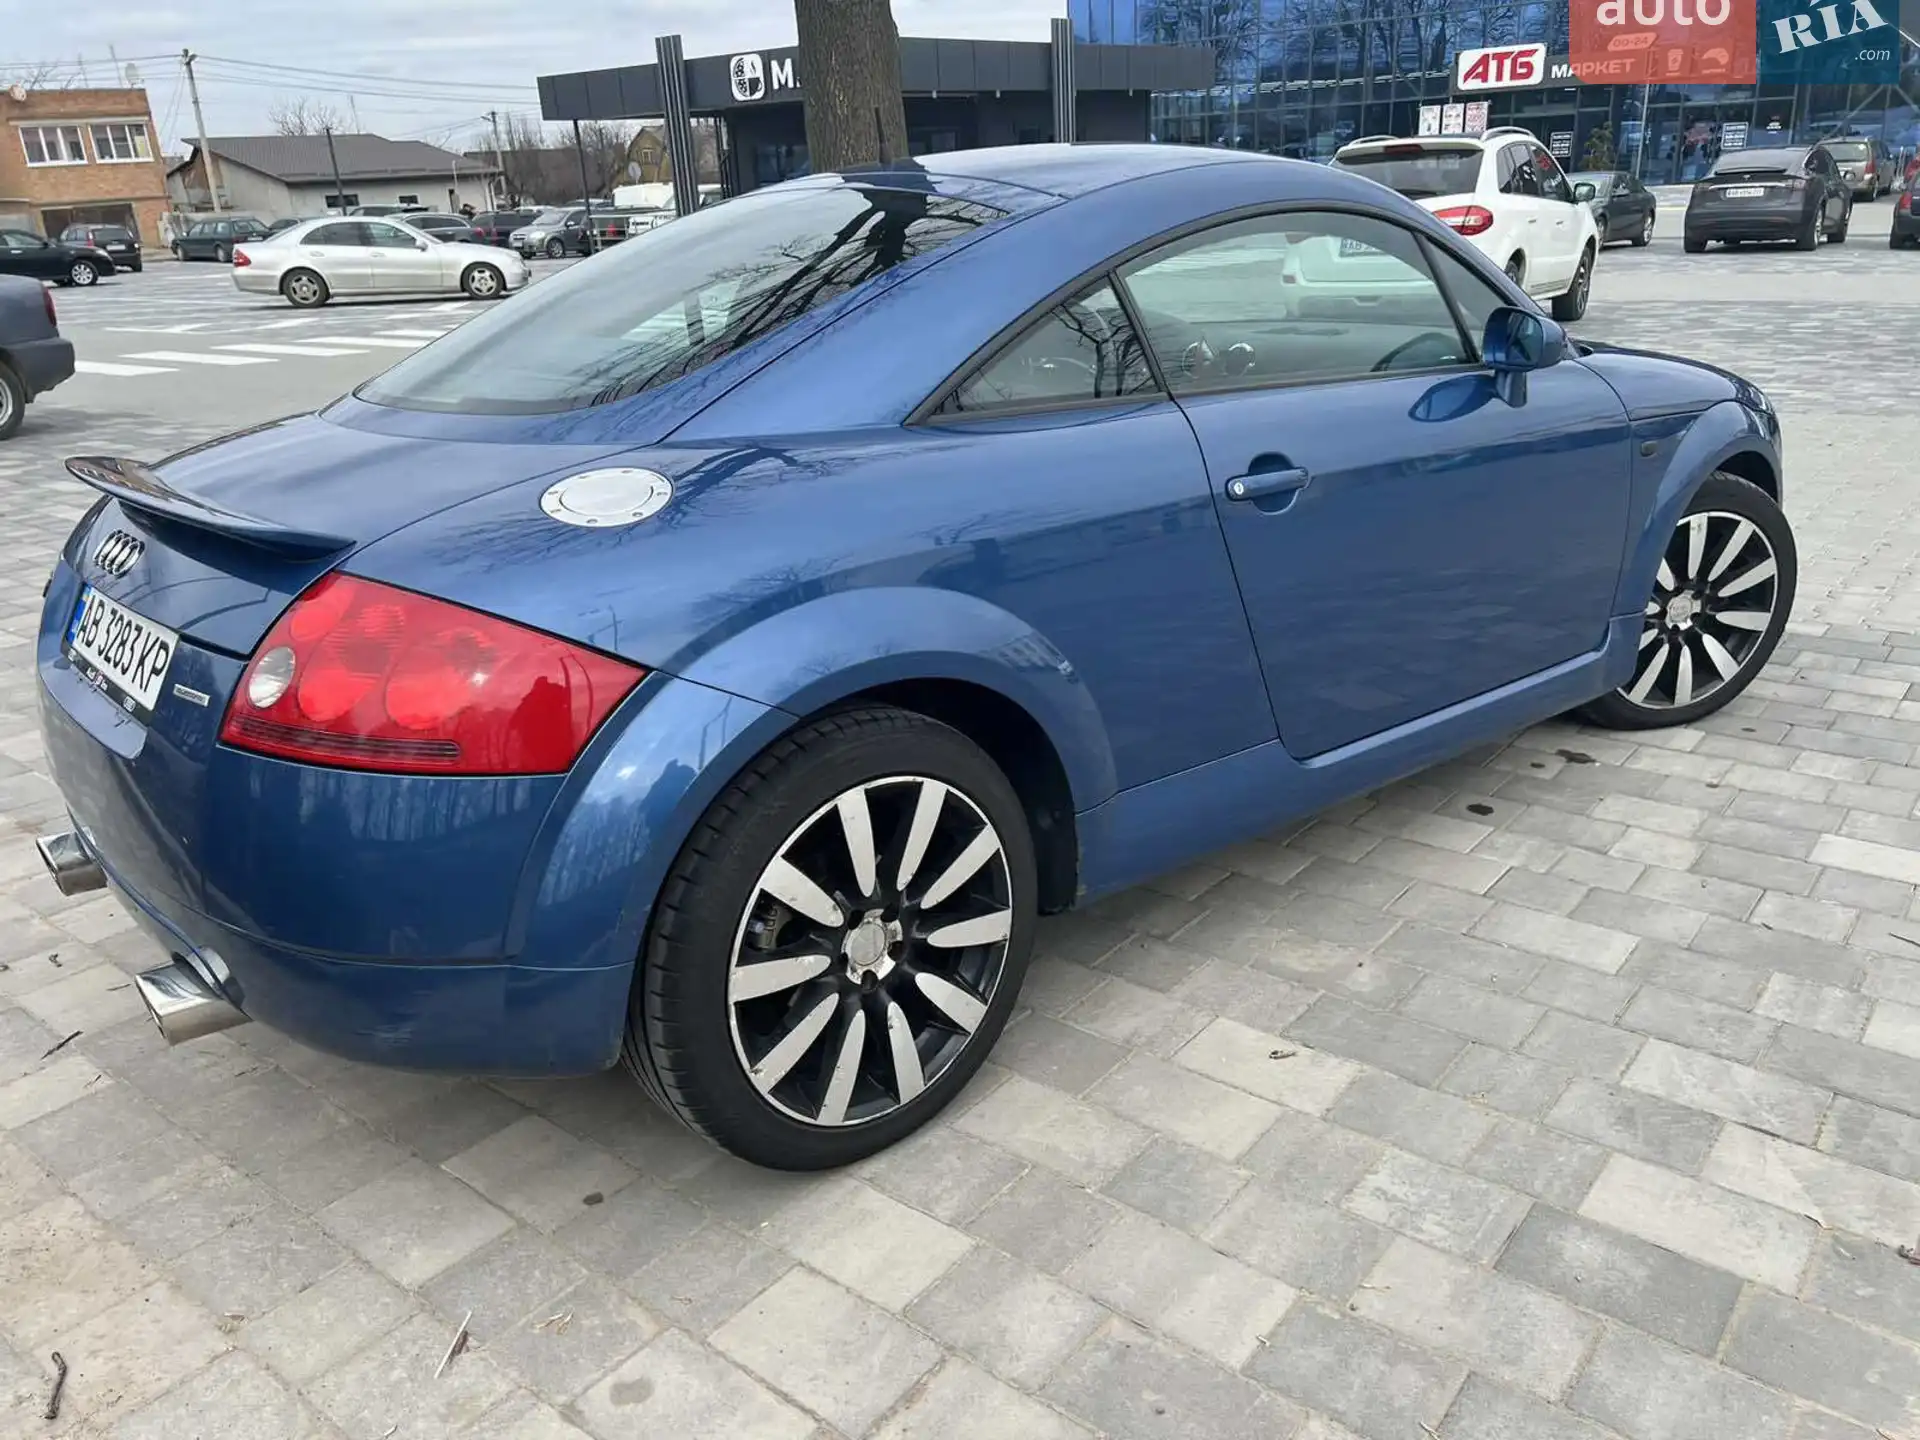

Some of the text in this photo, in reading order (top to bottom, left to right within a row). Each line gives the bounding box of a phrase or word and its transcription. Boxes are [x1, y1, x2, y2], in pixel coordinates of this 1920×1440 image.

[1463, 48, 1636, 85] АТБ МАРКЕТ
[77, 595, 105, 648] AB
[98, 607, 143, 675] 3283
[132, 631, 170, 693] KP
